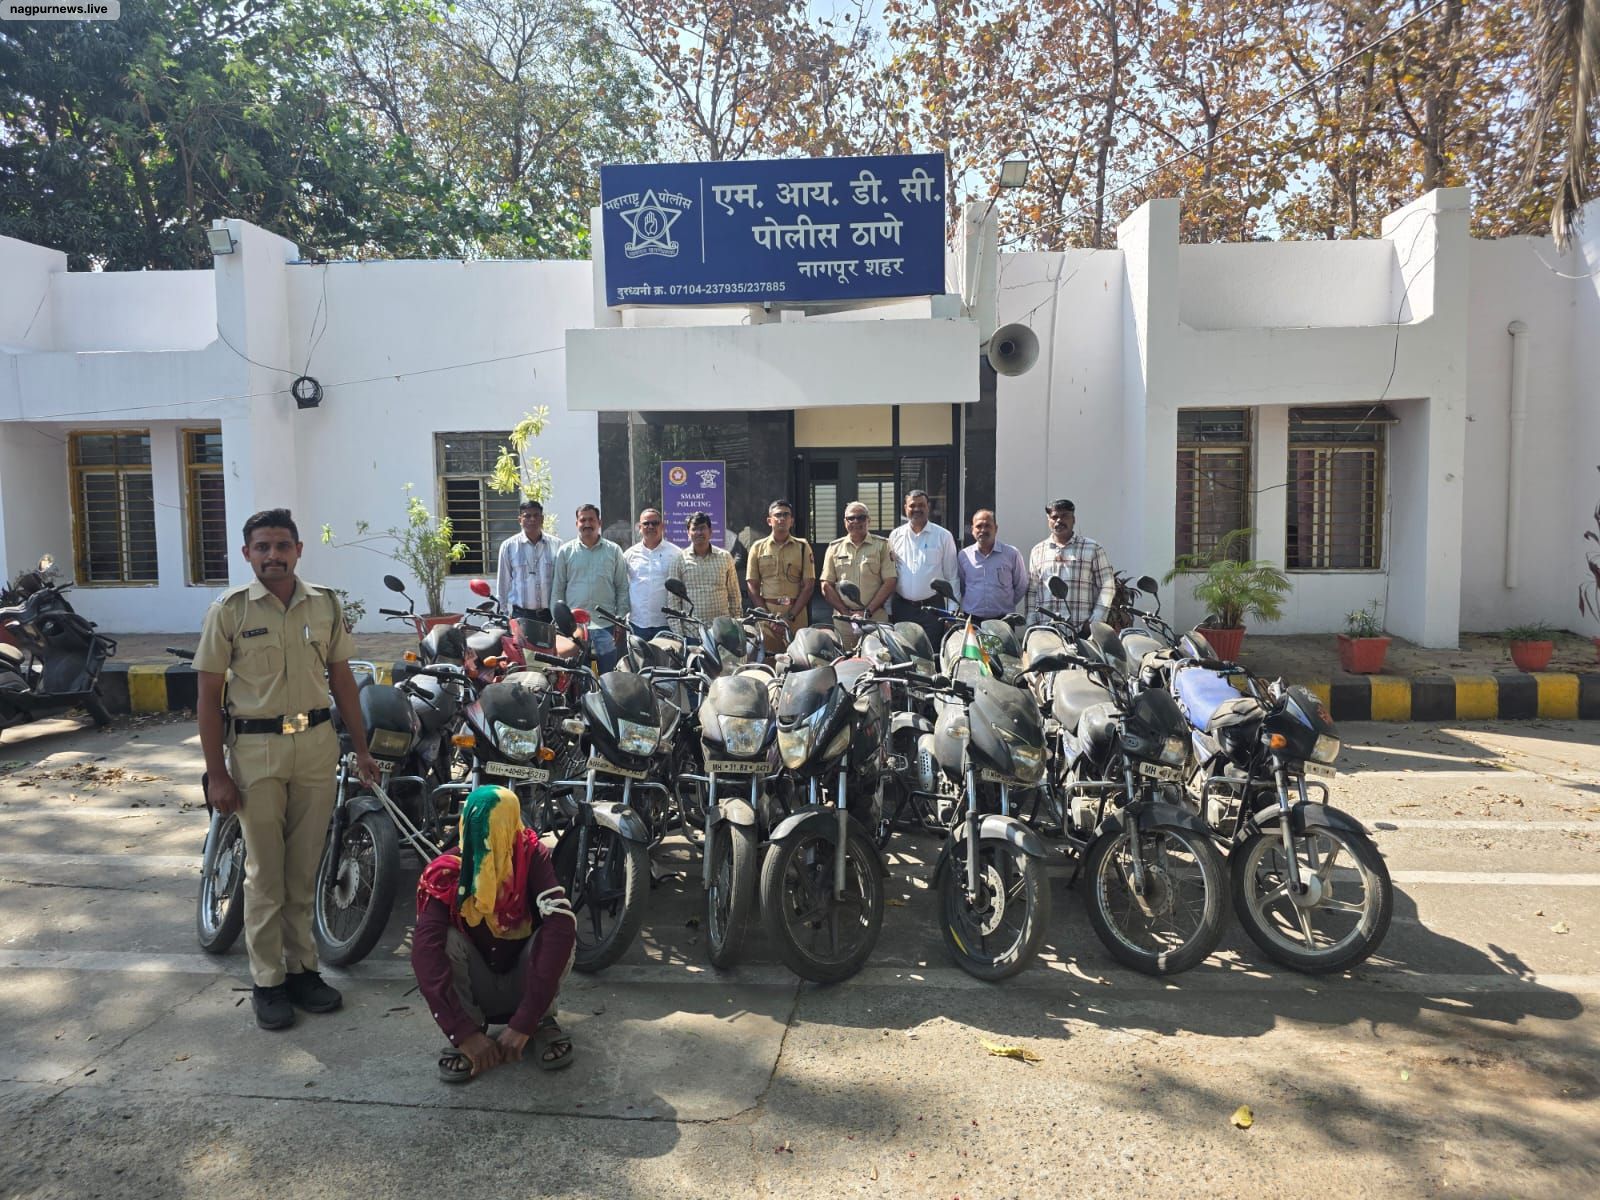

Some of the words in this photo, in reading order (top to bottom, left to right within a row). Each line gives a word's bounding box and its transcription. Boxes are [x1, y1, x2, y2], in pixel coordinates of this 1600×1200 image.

[603, 193, 640, 211] महाराष्ट्र
[658, 188, 693, 210] पोलीस
[712, 184, 764, 216] एम.
[776, 181, 839, 207] आय.
[850, 169, 888, 206] डी.
[899, 167, 941, 203] सी.
[752, 215, 840, 250] पोलीस
[850, 212, 904, 247] ठाणे
[797, 260, 860, 283] नागपूर
[864, 258, 904, 276] शहर
[669, 281, 786, 295] 07104-237935/237885
[1144, 764, 1157, 775] MH
